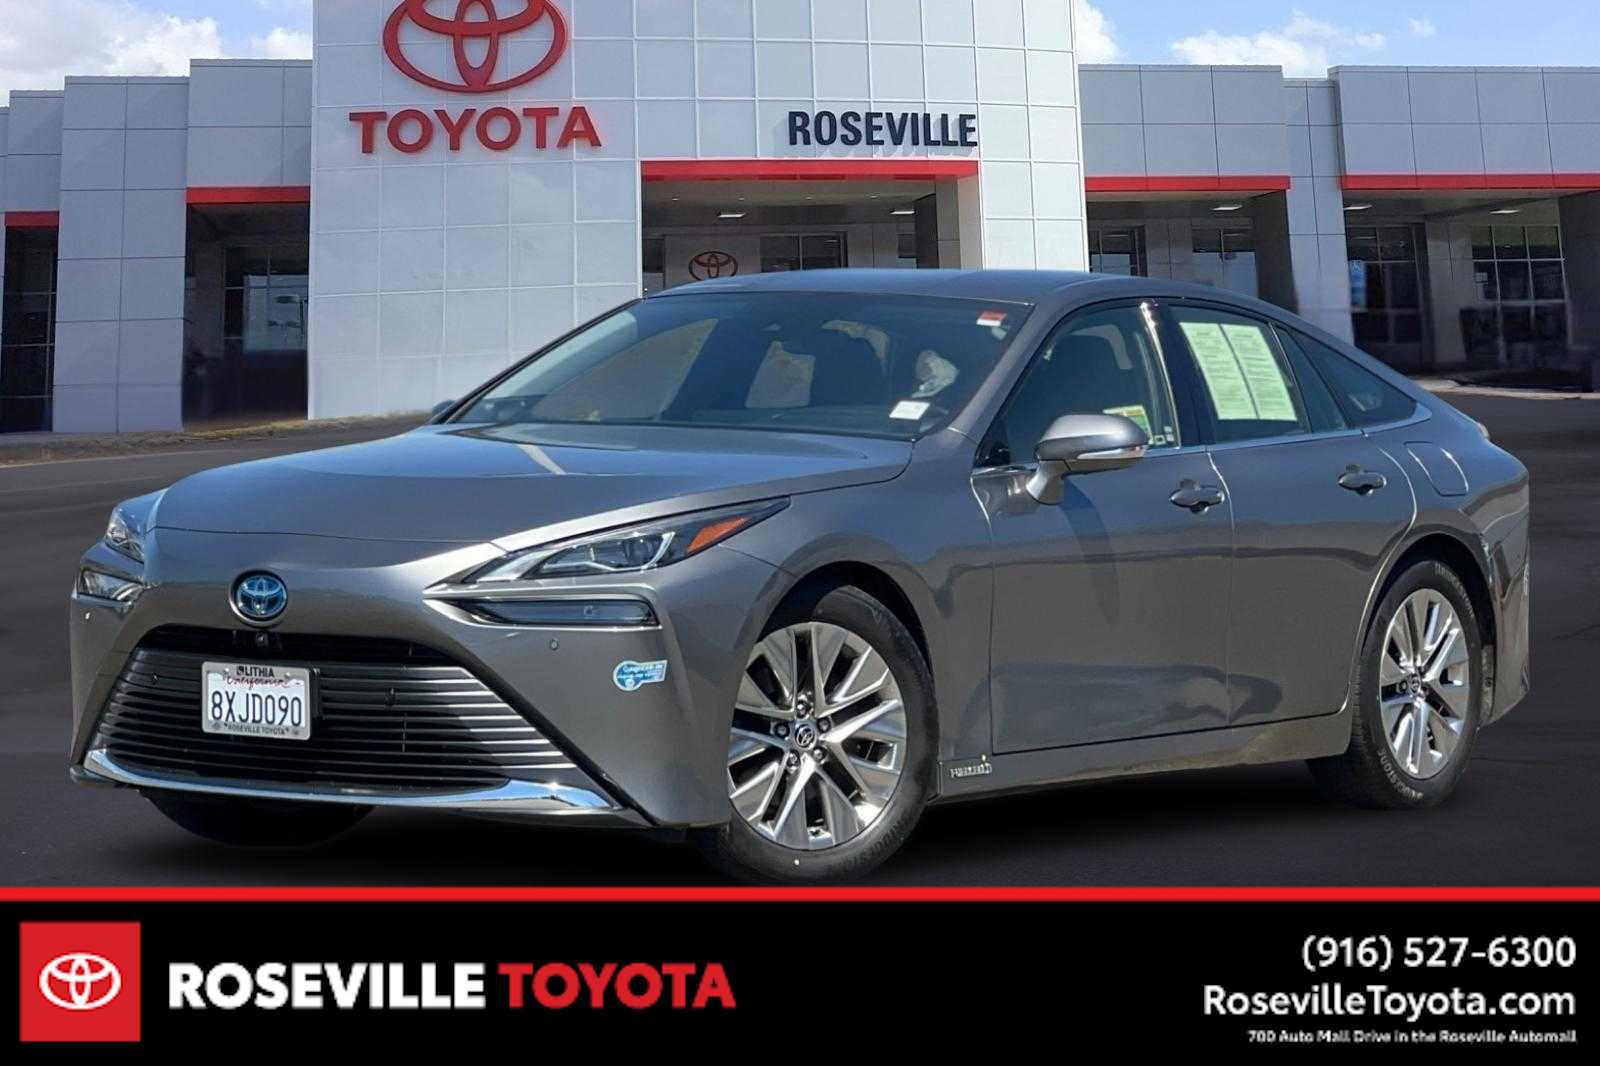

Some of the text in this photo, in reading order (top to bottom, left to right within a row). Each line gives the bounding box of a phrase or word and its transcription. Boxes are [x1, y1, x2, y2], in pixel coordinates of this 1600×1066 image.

[349, 106, 602, 153] TOYOTA
[789, 111, 978, 147] ROSEVILLE
[245, 666, 275, 678] LITHIA
[211, 690, 302, 727] 8XJD090
